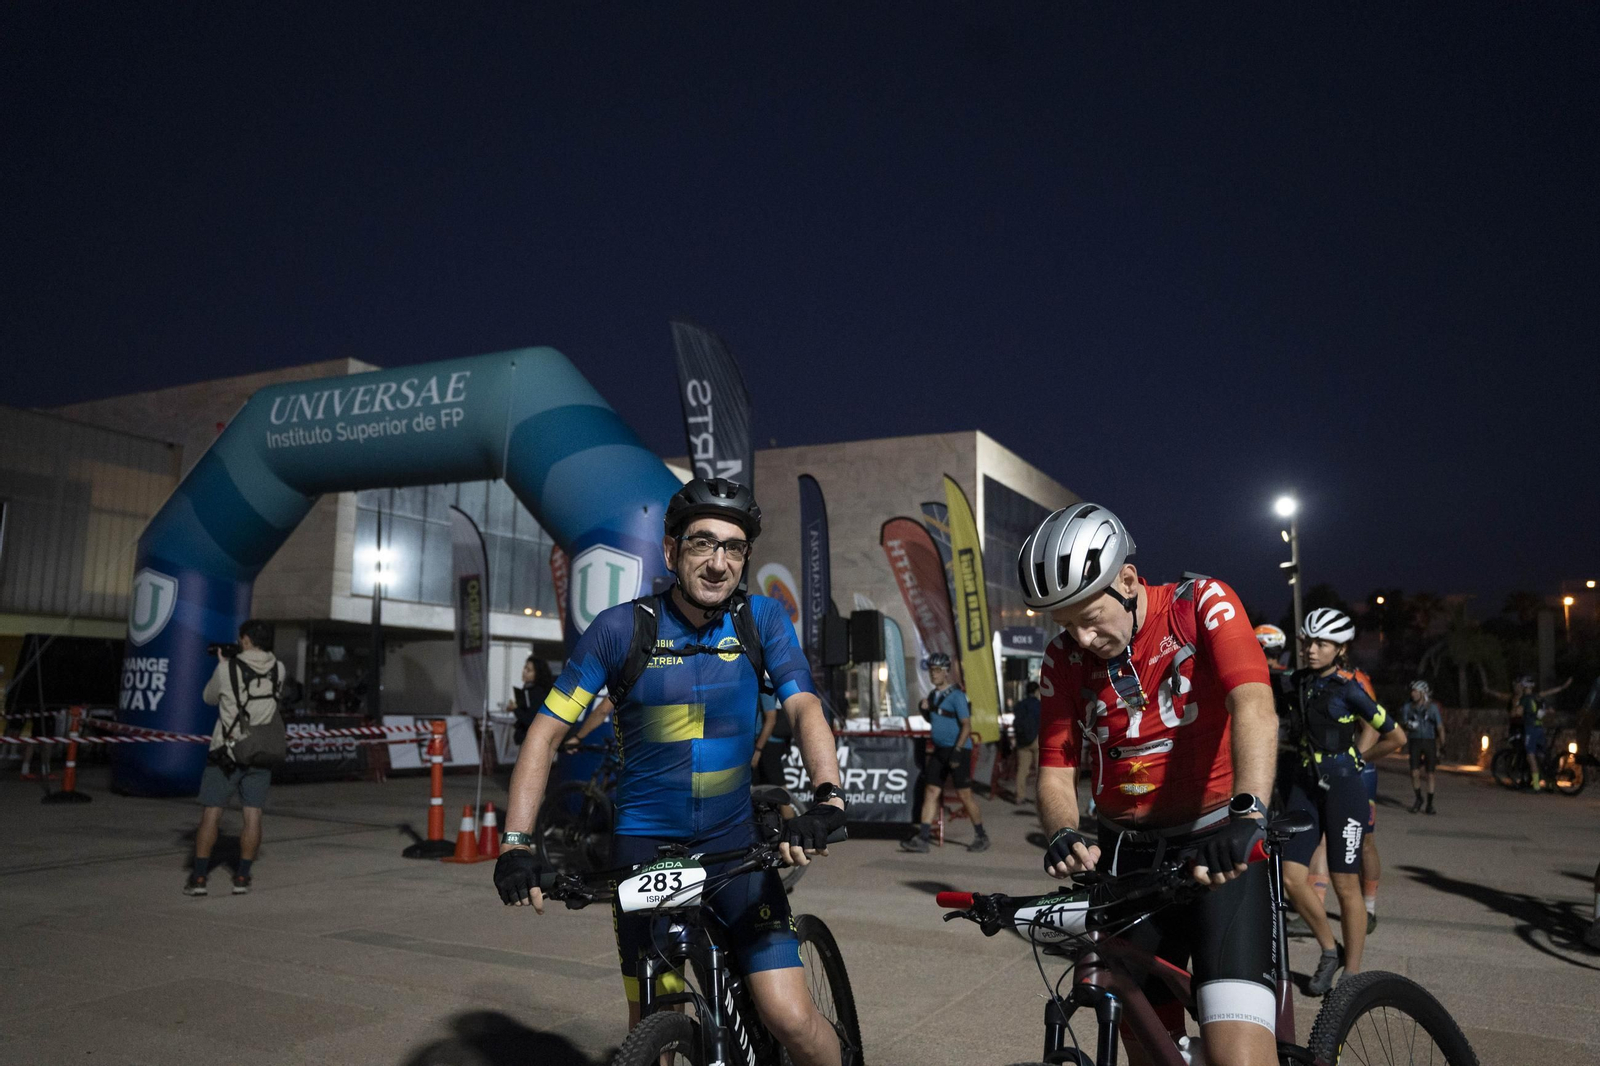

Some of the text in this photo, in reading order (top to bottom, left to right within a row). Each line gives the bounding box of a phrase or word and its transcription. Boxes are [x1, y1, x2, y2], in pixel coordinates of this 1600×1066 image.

[270, 371, 471, 425] UNIVERSAE
[266, 407, 464, 449] Instituto Superior de FP
[123, 657, 169, 673] HANGE
[648, 656, 684, 666] TREIA
[121, 672, 167, 691] OUR
[878, 790, 907, 803] feel
[1342, 818, 1362, 865] quality
[1354, 826, 1363, 849] team
[637, 871, 683, 893] 283
[646, 894, 676, 903] ISRAEL
